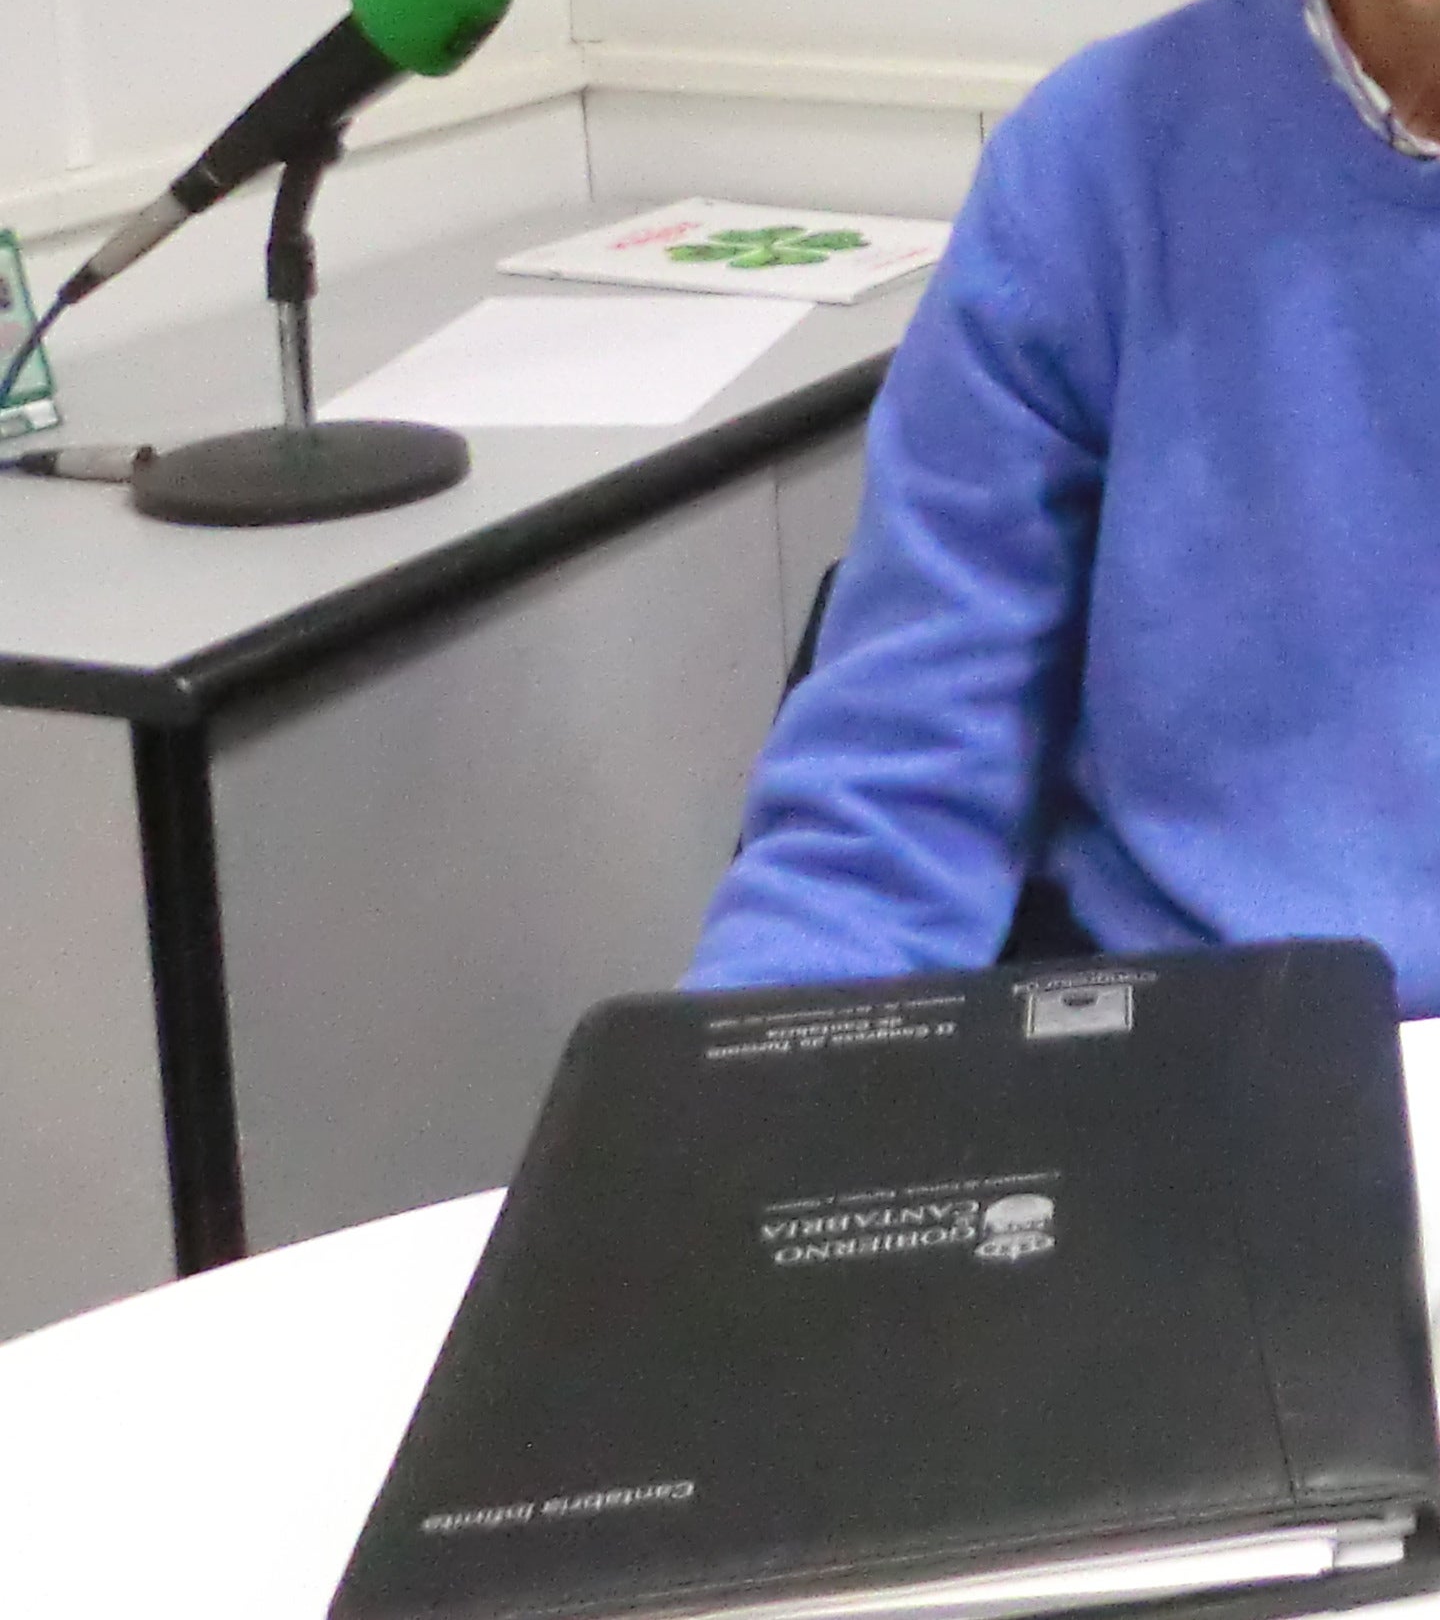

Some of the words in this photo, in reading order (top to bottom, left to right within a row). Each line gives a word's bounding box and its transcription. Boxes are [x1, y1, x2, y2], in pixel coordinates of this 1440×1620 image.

[760, 1199, 981, 1240] CANTABRIA
[774, 1226, 977, 1264] GOBIERNO
[540, 1481, 696, 1517] Cantabria
